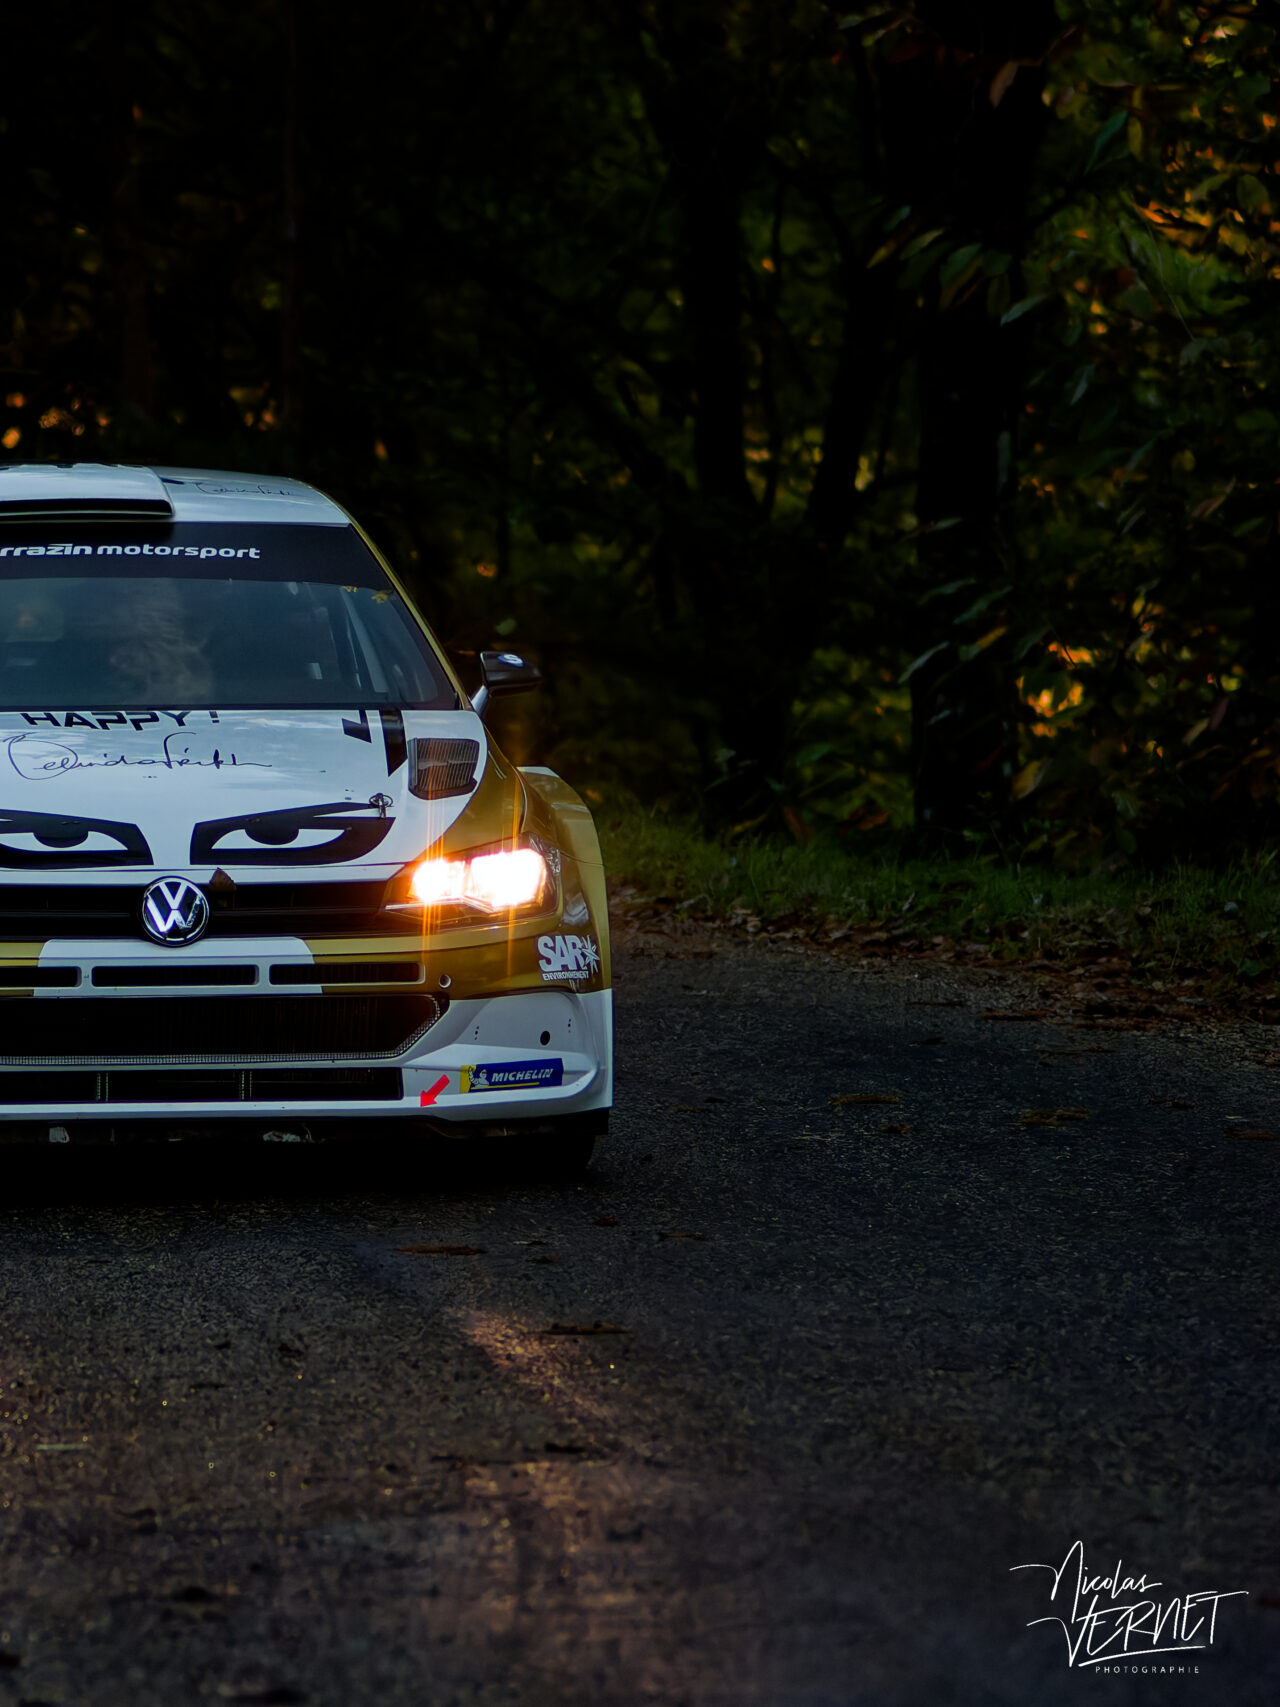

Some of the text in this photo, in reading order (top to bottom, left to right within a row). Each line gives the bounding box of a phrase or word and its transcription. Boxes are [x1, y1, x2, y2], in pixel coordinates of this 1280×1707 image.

[97, 543, 261, 559] motorsport
[537, 935, 587, 971] SAR
[542, 970, 589, 981] ENVIRONNEMENT
[491, 1068, 554, 1083] MICHELIN
